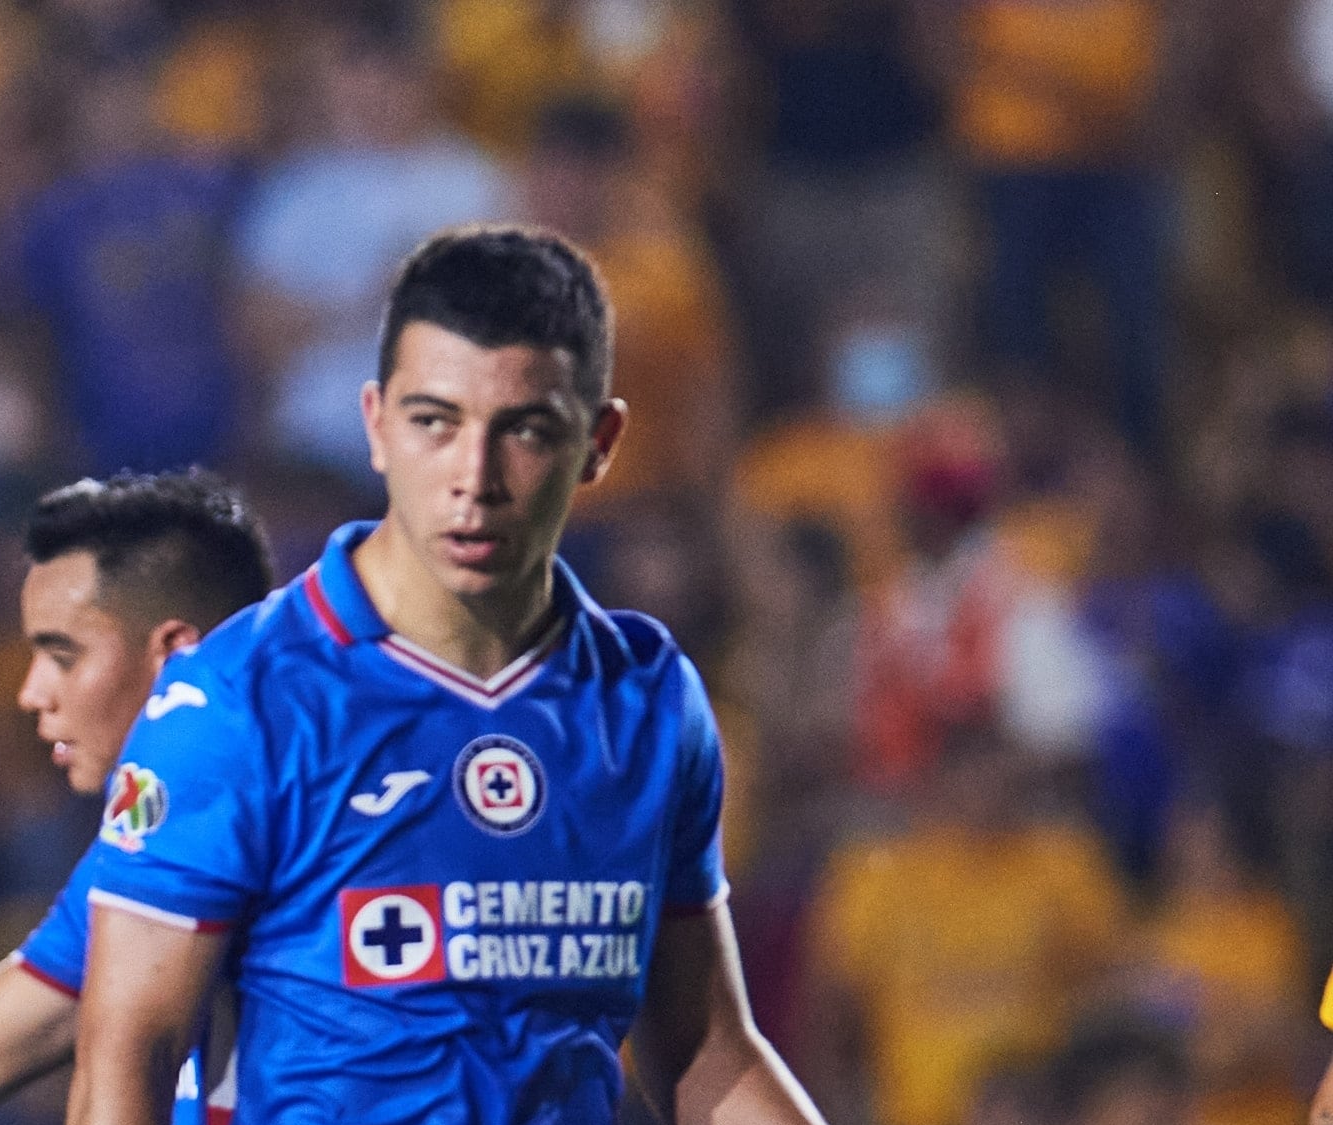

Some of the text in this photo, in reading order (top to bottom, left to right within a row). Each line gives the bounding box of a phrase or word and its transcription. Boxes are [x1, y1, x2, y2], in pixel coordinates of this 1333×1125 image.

[443, 880, 645, 928] CEMENTO
[447, 933, 641, 981] CRUZ AZUL
